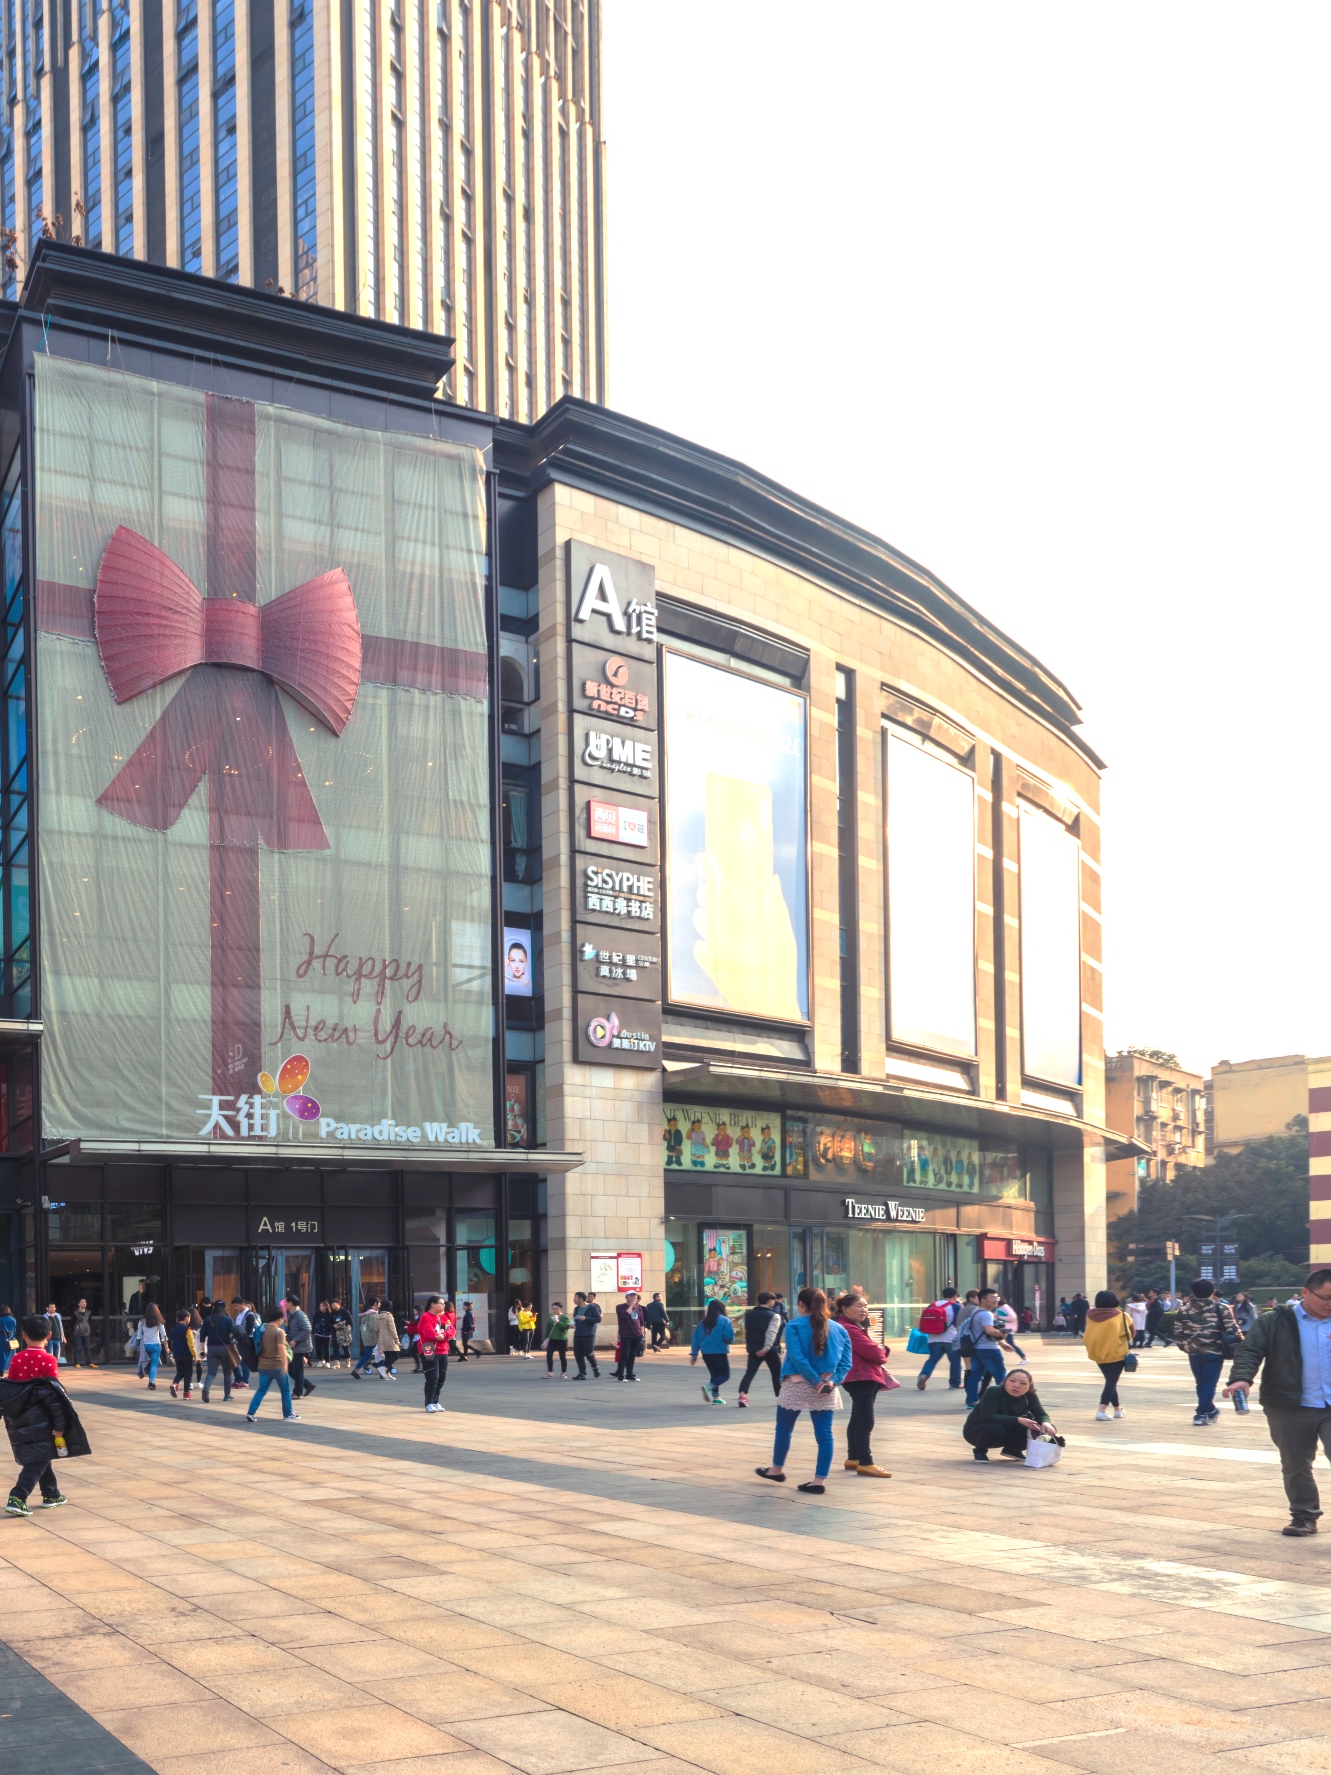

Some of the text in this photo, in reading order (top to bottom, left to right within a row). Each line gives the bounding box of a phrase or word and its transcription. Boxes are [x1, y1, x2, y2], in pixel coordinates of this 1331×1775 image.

[575, 562, 658, 643] A馆
[594, 807, 616, 824] 西贝
[587, 893, 654, 919] 西西弗书店
[295, 932, 423, 1006] Happy
[268, 1004, 463, 1060] New Year
[195, 1093, 482, 1144] 天街 Paradise Walk
[729, 1113, 757, 1129] BEAR
[845, 1198, 926, 1222] TEENIE WEENIE
[290, 1221, 318, 1233] 1号门
